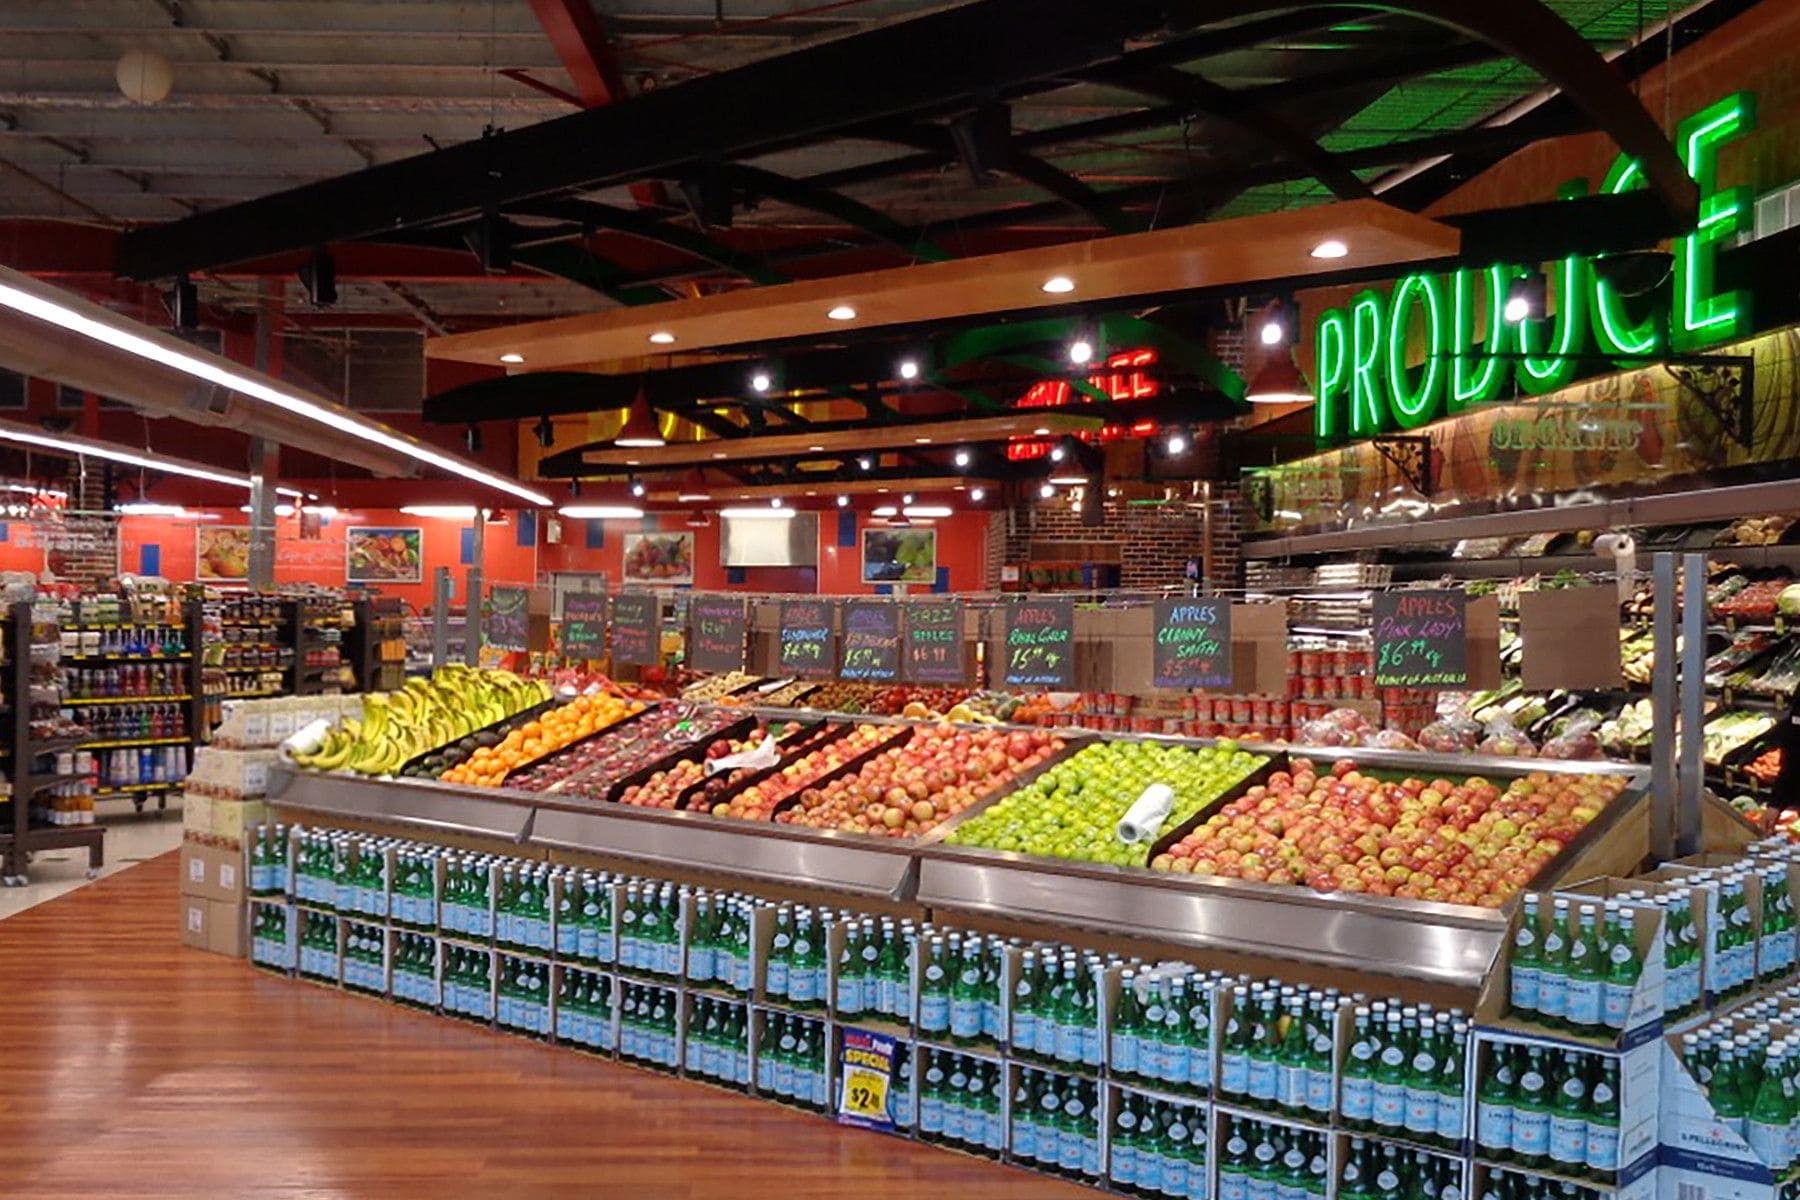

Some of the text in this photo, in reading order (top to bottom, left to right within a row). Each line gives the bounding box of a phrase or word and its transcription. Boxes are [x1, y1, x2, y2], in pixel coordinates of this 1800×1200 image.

[1315, 90, 1757, 450] PRODUCE
[1169, 606, 1217, 625] APPLES
[1395, 597, 1456, 617] APPLES
[1176, 639, 1220, 658] SMITH
